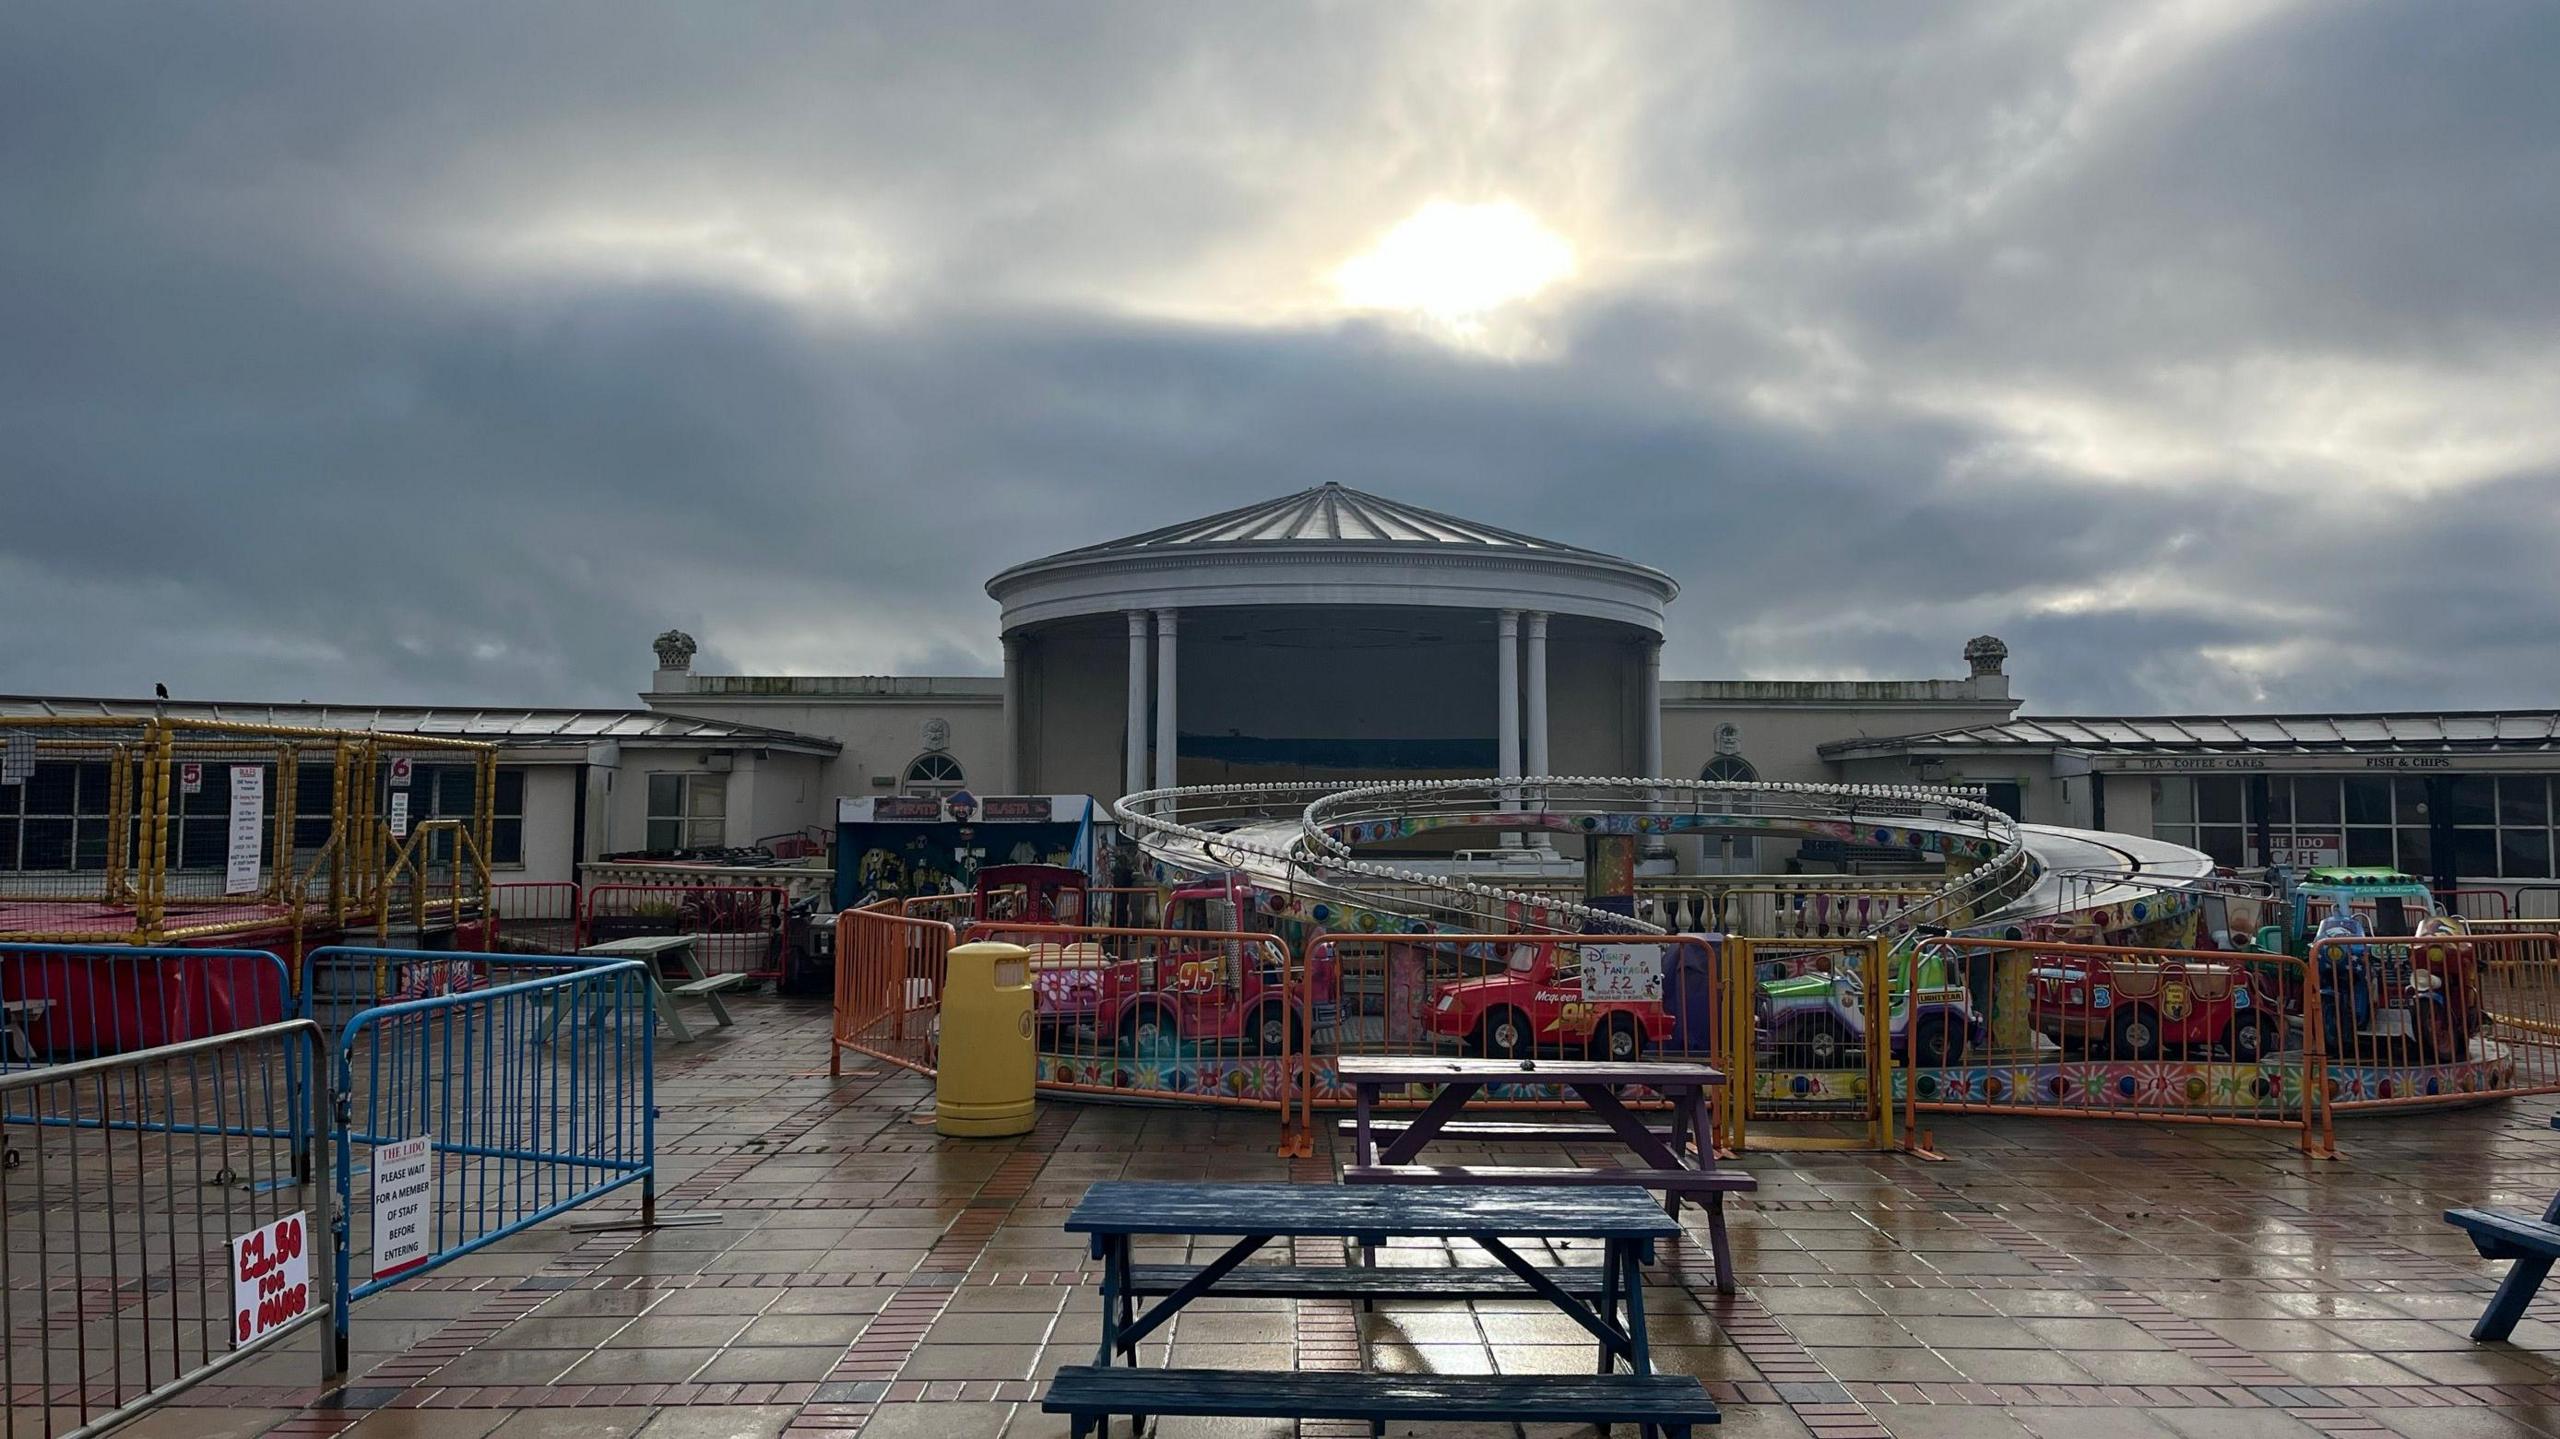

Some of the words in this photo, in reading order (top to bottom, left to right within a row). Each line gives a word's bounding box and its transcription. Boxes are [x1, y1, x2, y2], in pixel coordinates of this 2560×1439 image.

[2142, 759, 2163, 768] TEA
[2226, 758, 2265, 768] CAKES
[2366, 757, 2394, 767] FISH
[2398, 757, 2409, 767] &
[2412, 757, 2450, 767] CHIPS
[183, 764, 200, 784] 5
[2270, 837, 2289, 848] HE
[2296, 837, 2324, 848] IDO
[1179, 961, 1215, 993] 95
[1610, 975, 1633, 990] £2
[382, 1147, 402, 1161] THE
[403, 1140, 425, 1155] LIDO
[380, 1168, 406, 1184] PLEASE
[407, 1163, 426, 1177] WAIT
[375, 1191, 391, 1205] FOR
[391, 1190, 398, 1200] A
[398, 1181, 430, 1199] MEMBER
[387, 1210, 398, 1221] OF
[398, 1203, 419, 1219] STAFF
[389, 1223, 416, 1240] BEFORE
[240, 1218, 302, 1282] £1.50
[384, 1241, 419, 1261] ENTERING
[258, 1269, 286, 1300] FOR
[238, 1309, 251, 1341] 5
[257, 1283, 307, 1333] MINS
